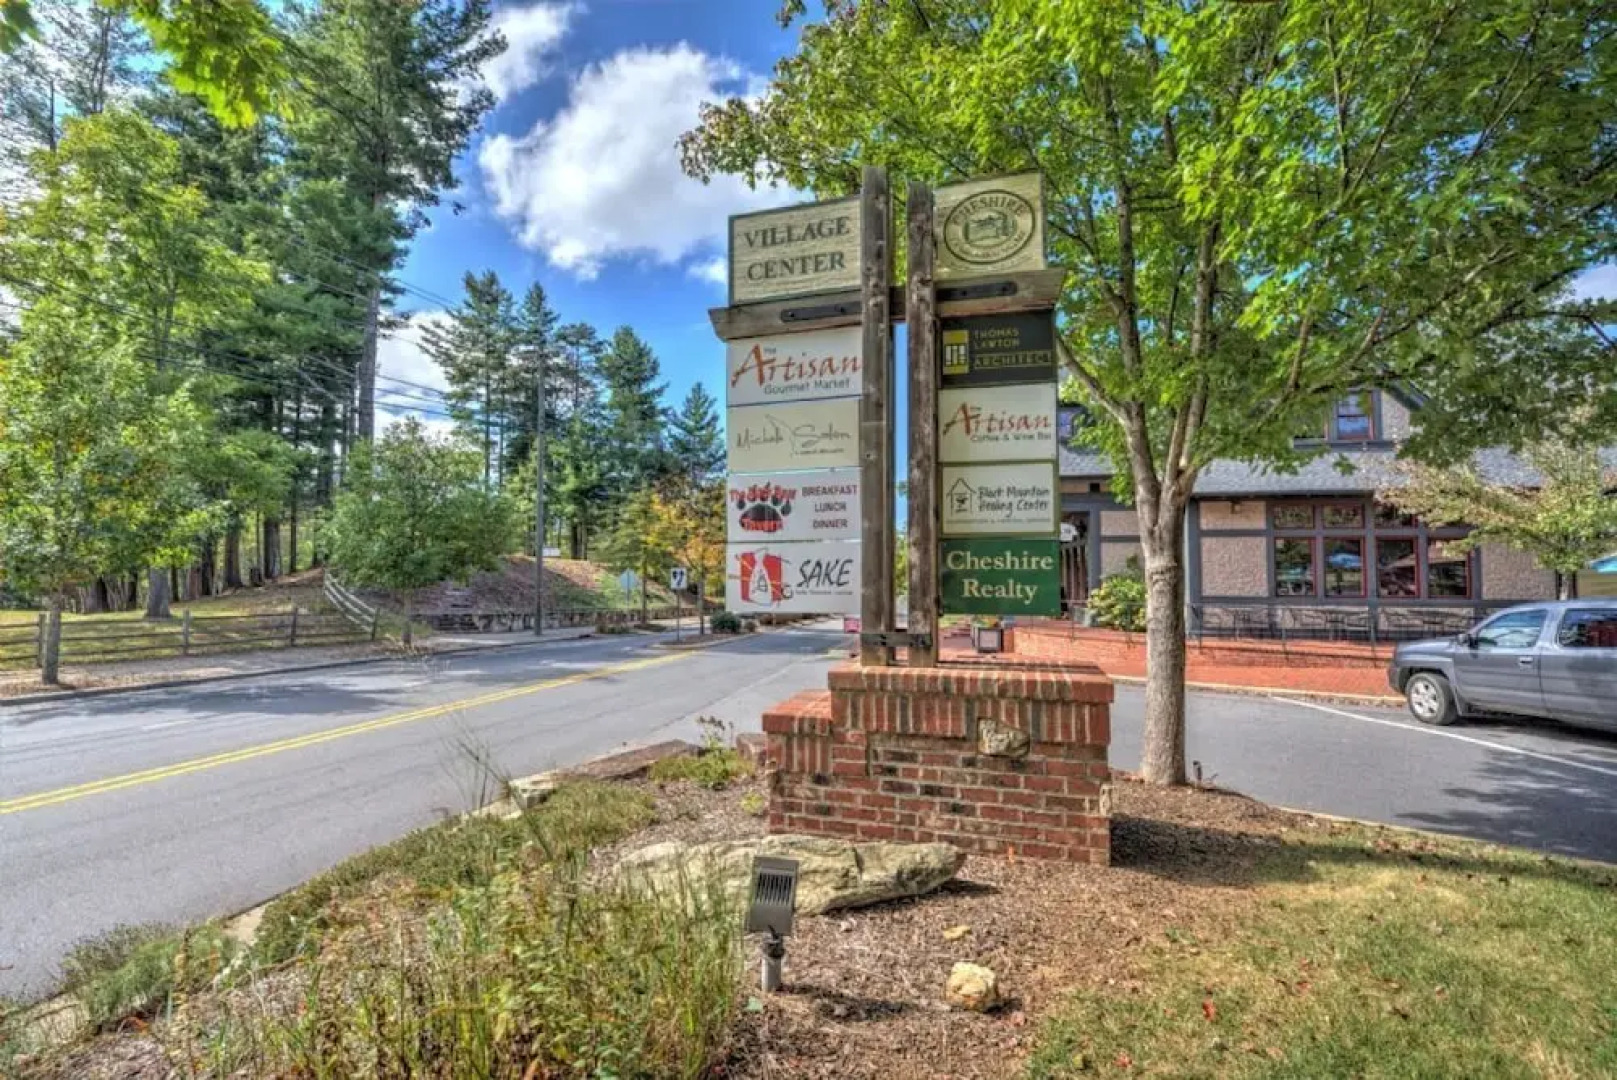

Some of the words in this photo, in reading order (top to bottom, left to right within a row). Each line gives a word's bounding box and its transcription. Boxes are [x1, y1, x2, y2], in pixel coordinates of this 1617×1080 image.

[951, 196, 1030, 227] CHESHIRE
[744, 216, 850, 248] VILLAGE
[747, 251, 845, 281] CENTER
[974, 327, 1020, 339] THOMAS
[731, 344, 861, 388] Artisan
[764, 381, 810, 395] Gourmet
[814, 377, 850, 389] Market
[942, 402, 1051, 435] Artisan
[801, 485, 858, 497] BREAKFAST
[814, 502, 847, 513] LUNCH
[812, 518, 848, 530] DINNER
[797, 558, 854, 588] SAKE
[946, 550, 1054, 571] Cheshire
[961, 578, 1039, 606] Realty
